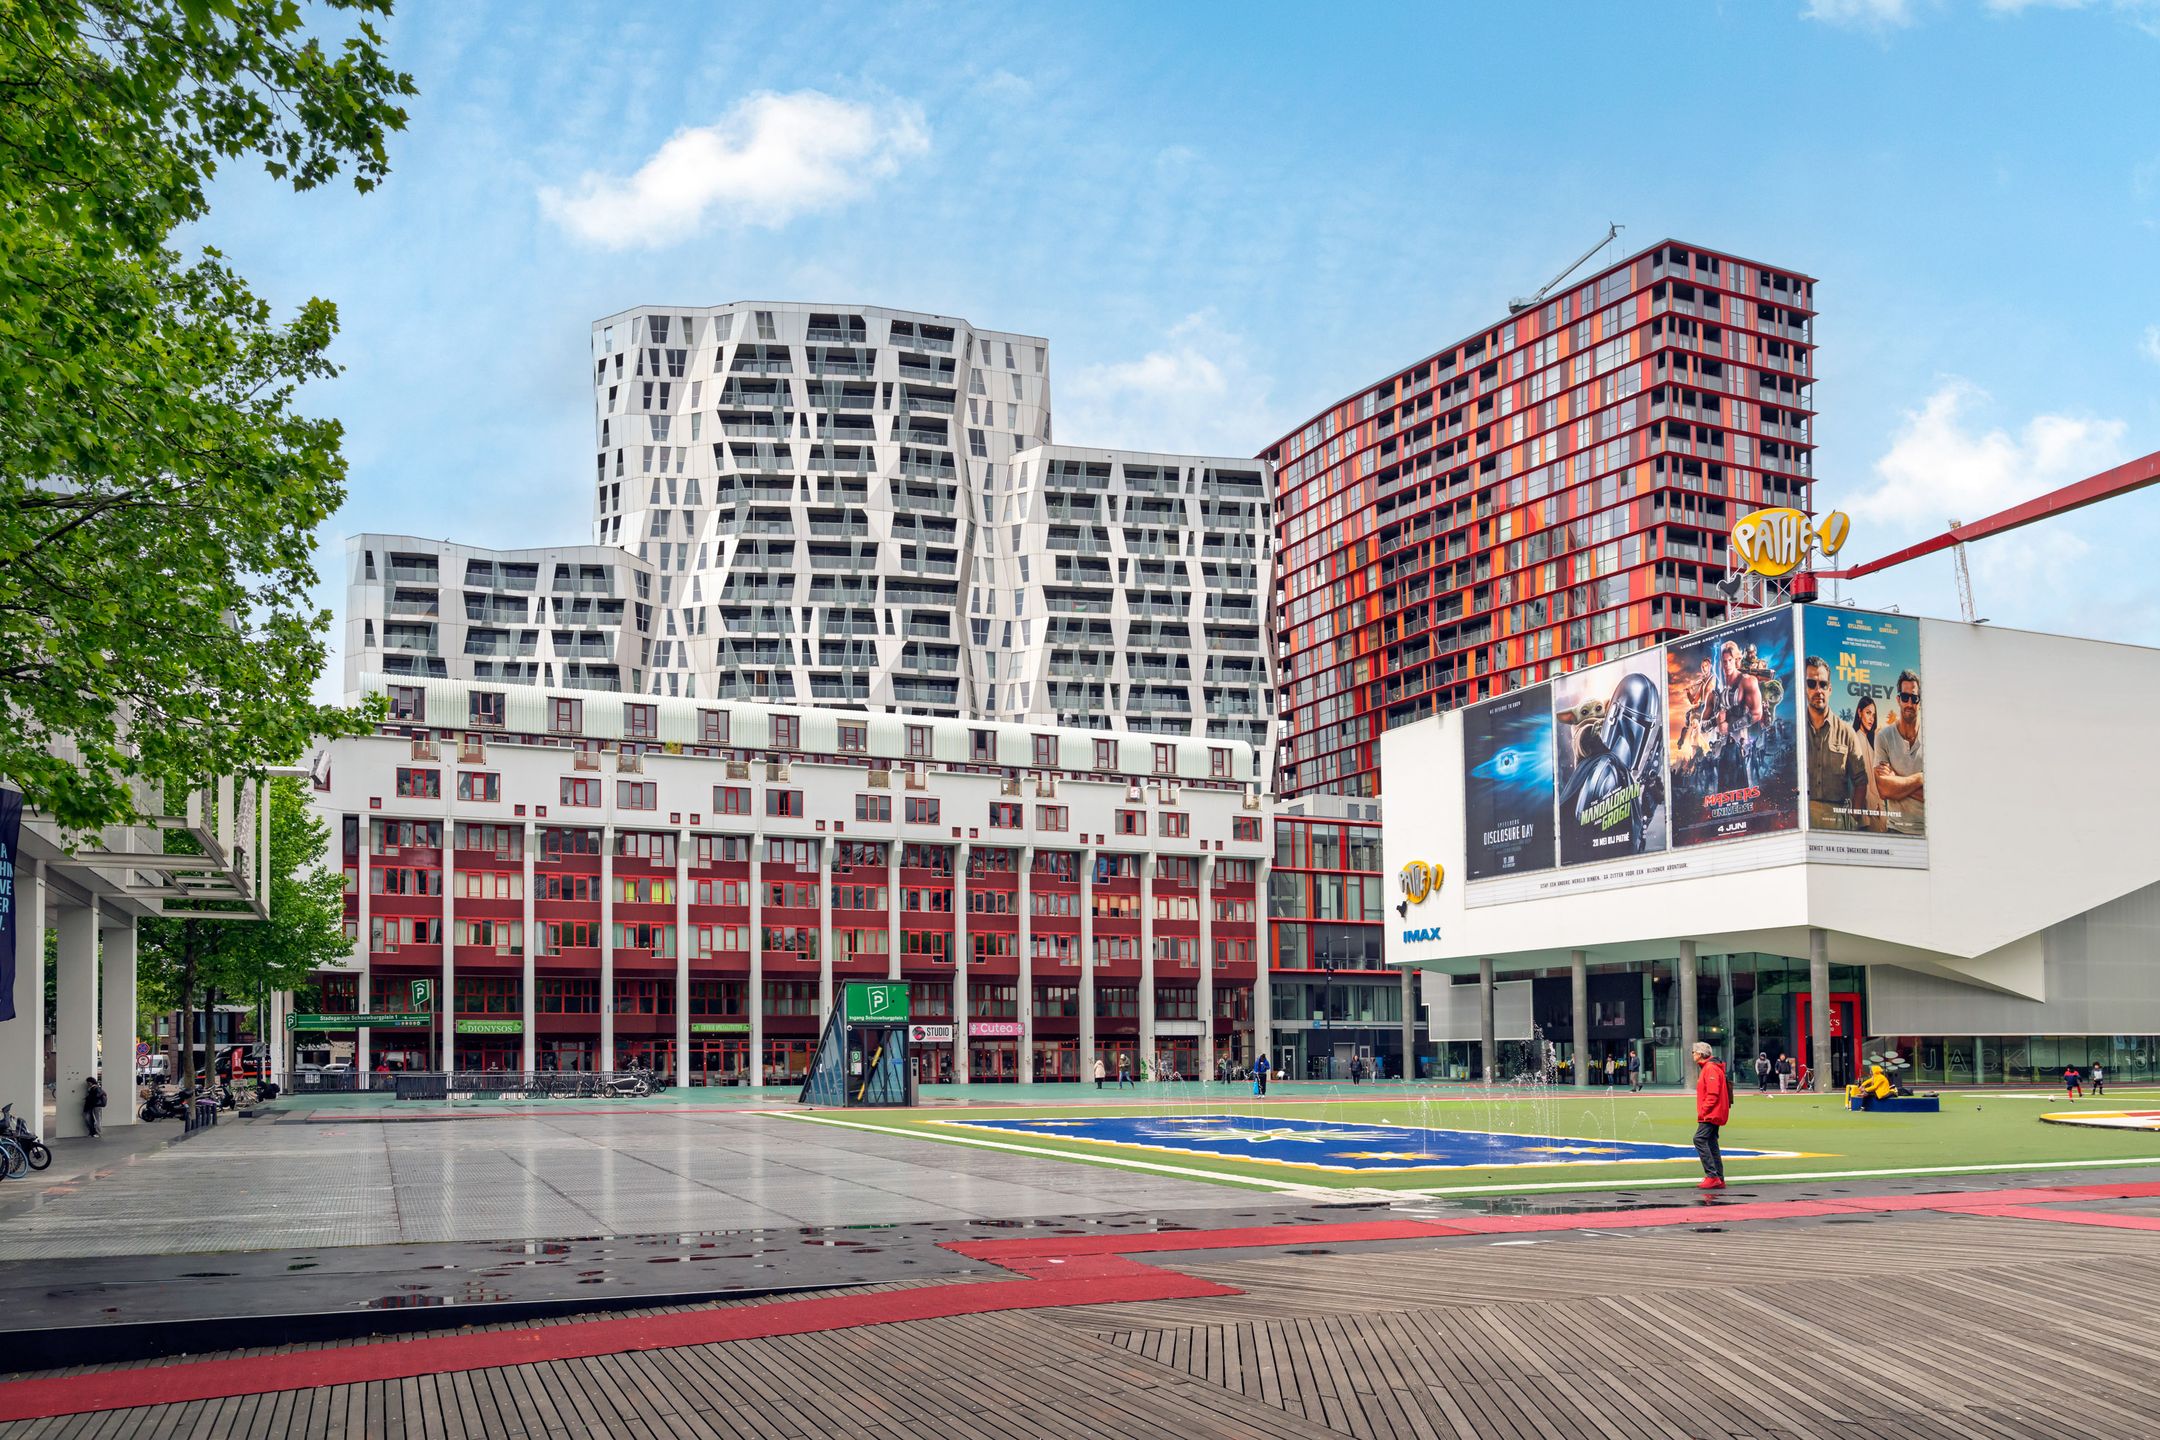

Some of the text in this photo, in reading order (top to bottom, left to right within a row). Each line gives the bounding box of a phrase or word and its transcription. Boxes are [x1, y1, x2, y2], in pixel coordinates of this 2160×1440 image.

[1840, 652, 1856, 668] IN
[1836, 666, 1871, 684] THE
[1847, 681, 1894, 700] GREY
[1580, 783, 1641, 826] MANDALORIAN
[1703, 785, 1761, 808] MASTERS
[1602, 801, 1631, 831] GROGU
[1712, 802, 1754, 817] UNIVERSE
[1483, 824, 1534, 845] DISCLOSURE DAY
[1726, 821, 1747, 832] JUNI
[1403, 927, 1442, 944] IMAX
[467, 1025, 513, 1033] DIONYSOS
[926, 1027, 950, 1037] STUDIO
